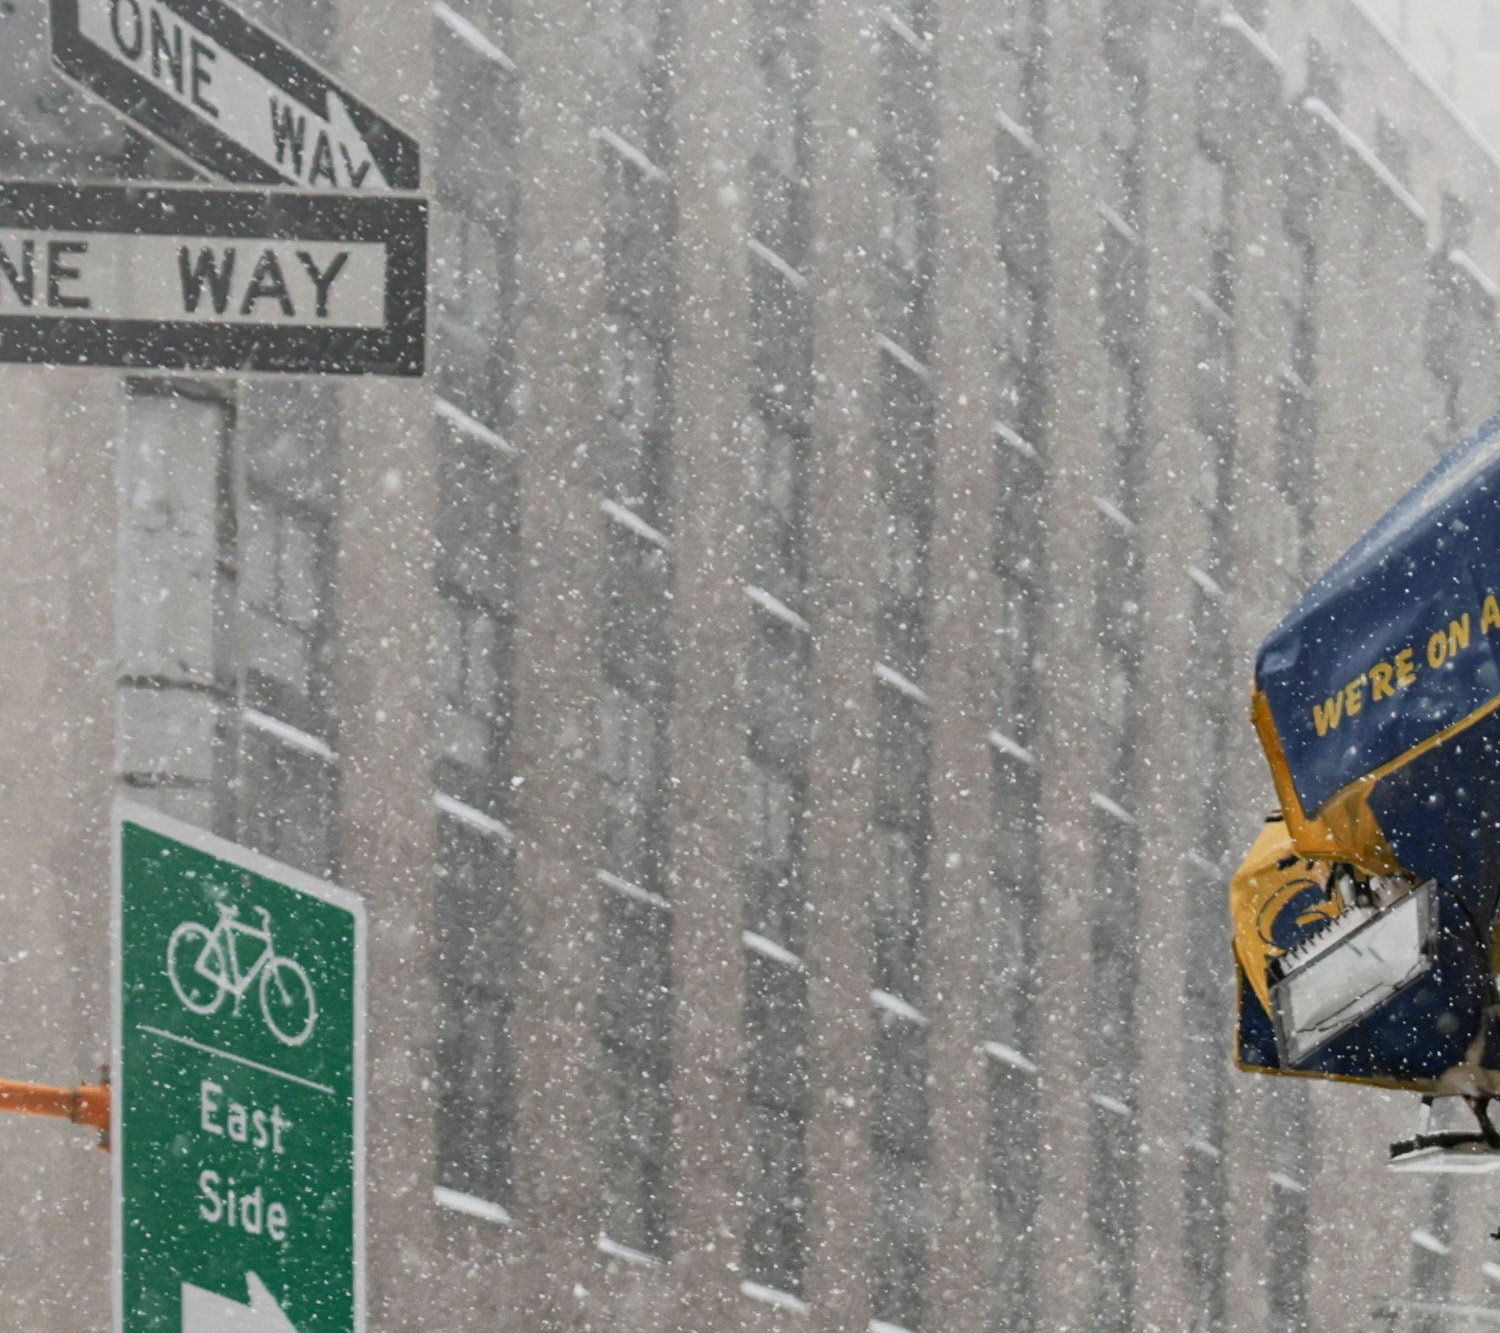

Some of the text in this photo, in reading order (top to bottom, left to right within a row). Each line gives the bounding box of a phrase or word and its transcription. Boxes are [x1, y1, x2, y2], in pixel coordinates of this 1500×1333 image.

[110, 0, 371, 190] ONE WAY
[0, 238, 351, 319] NE WAY
[1312, 647, 1417, 738] WE'RE
[1426, 611, 1470, 670] ON
[200, 1079, 293, 1157] East
[199, 1169, 289, 1242] Side
